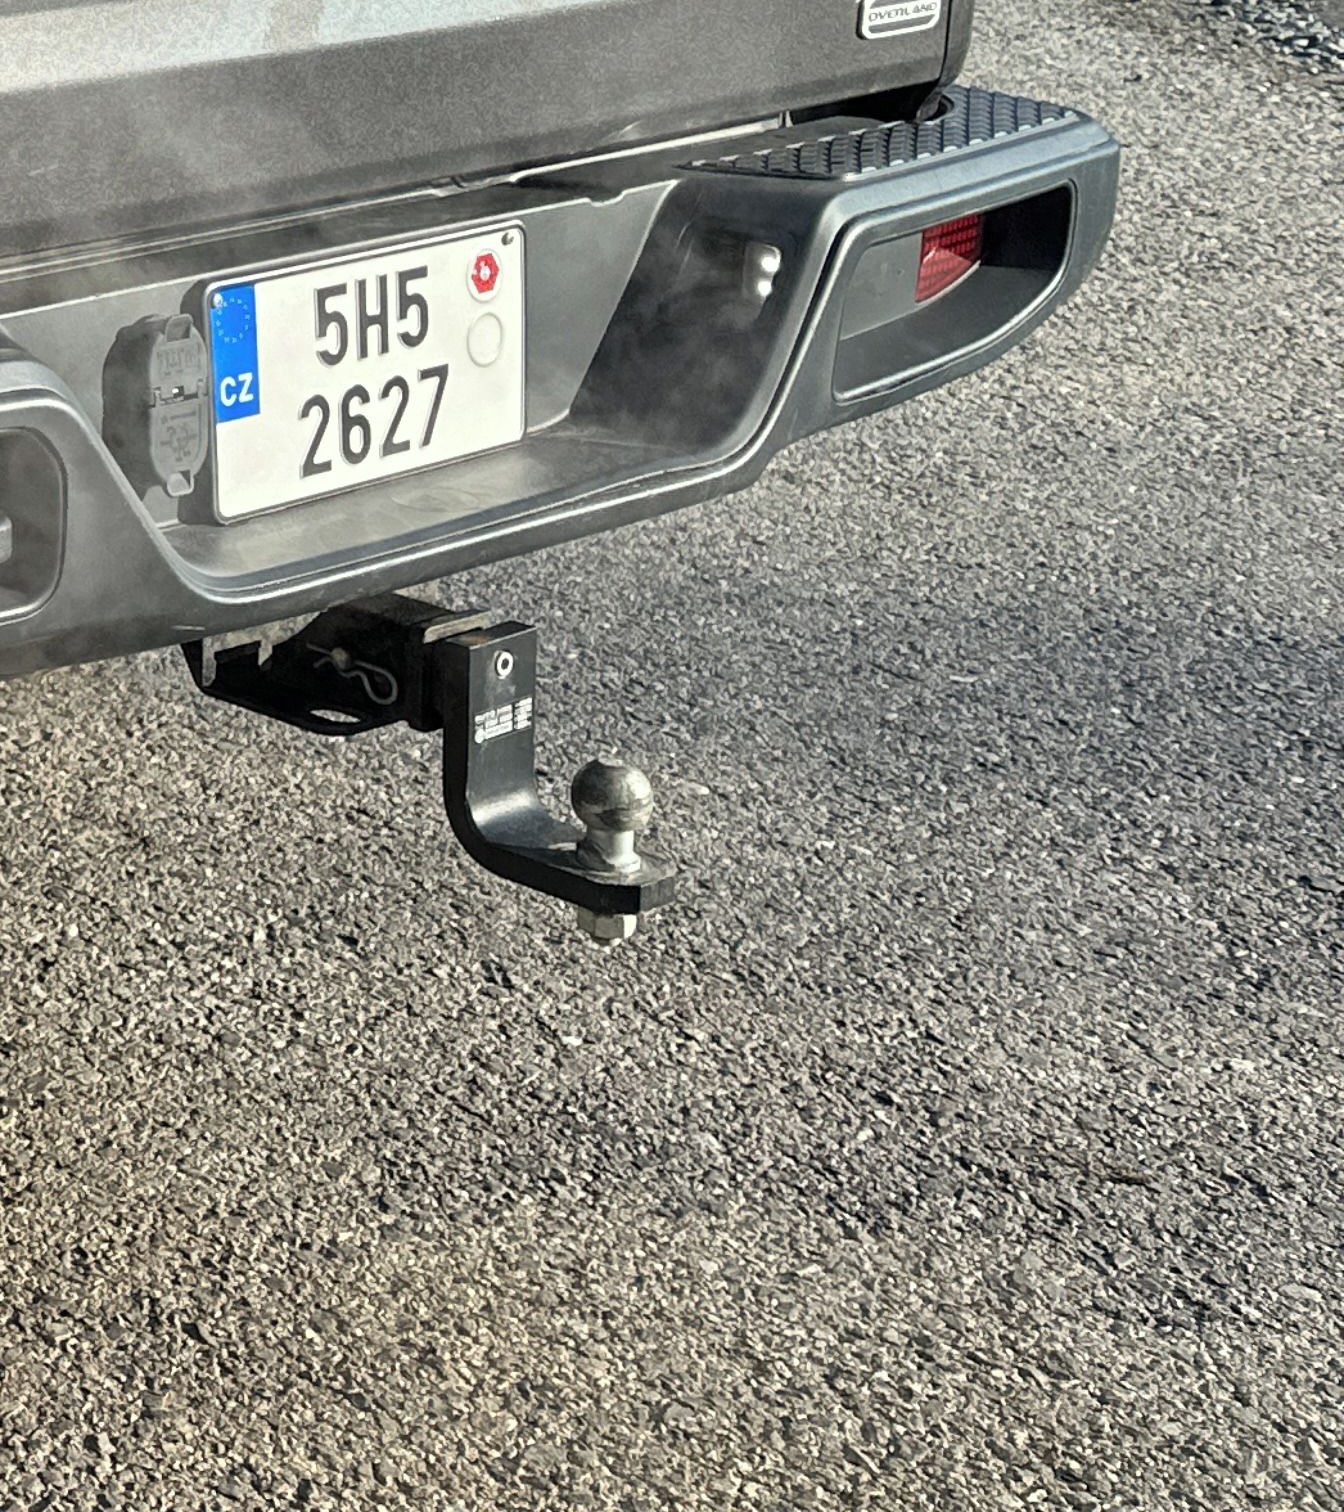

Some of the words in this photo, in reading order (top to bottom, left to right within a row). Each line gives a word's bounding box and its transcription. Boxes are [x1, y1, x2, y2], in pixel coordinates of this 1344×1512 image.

[868, 2, 937, 22] OVERLAND
[314, 265, 429, 367] 5H5
[220, 372, 254, 407] CZ
[298, 363, 449, 479] 2627
